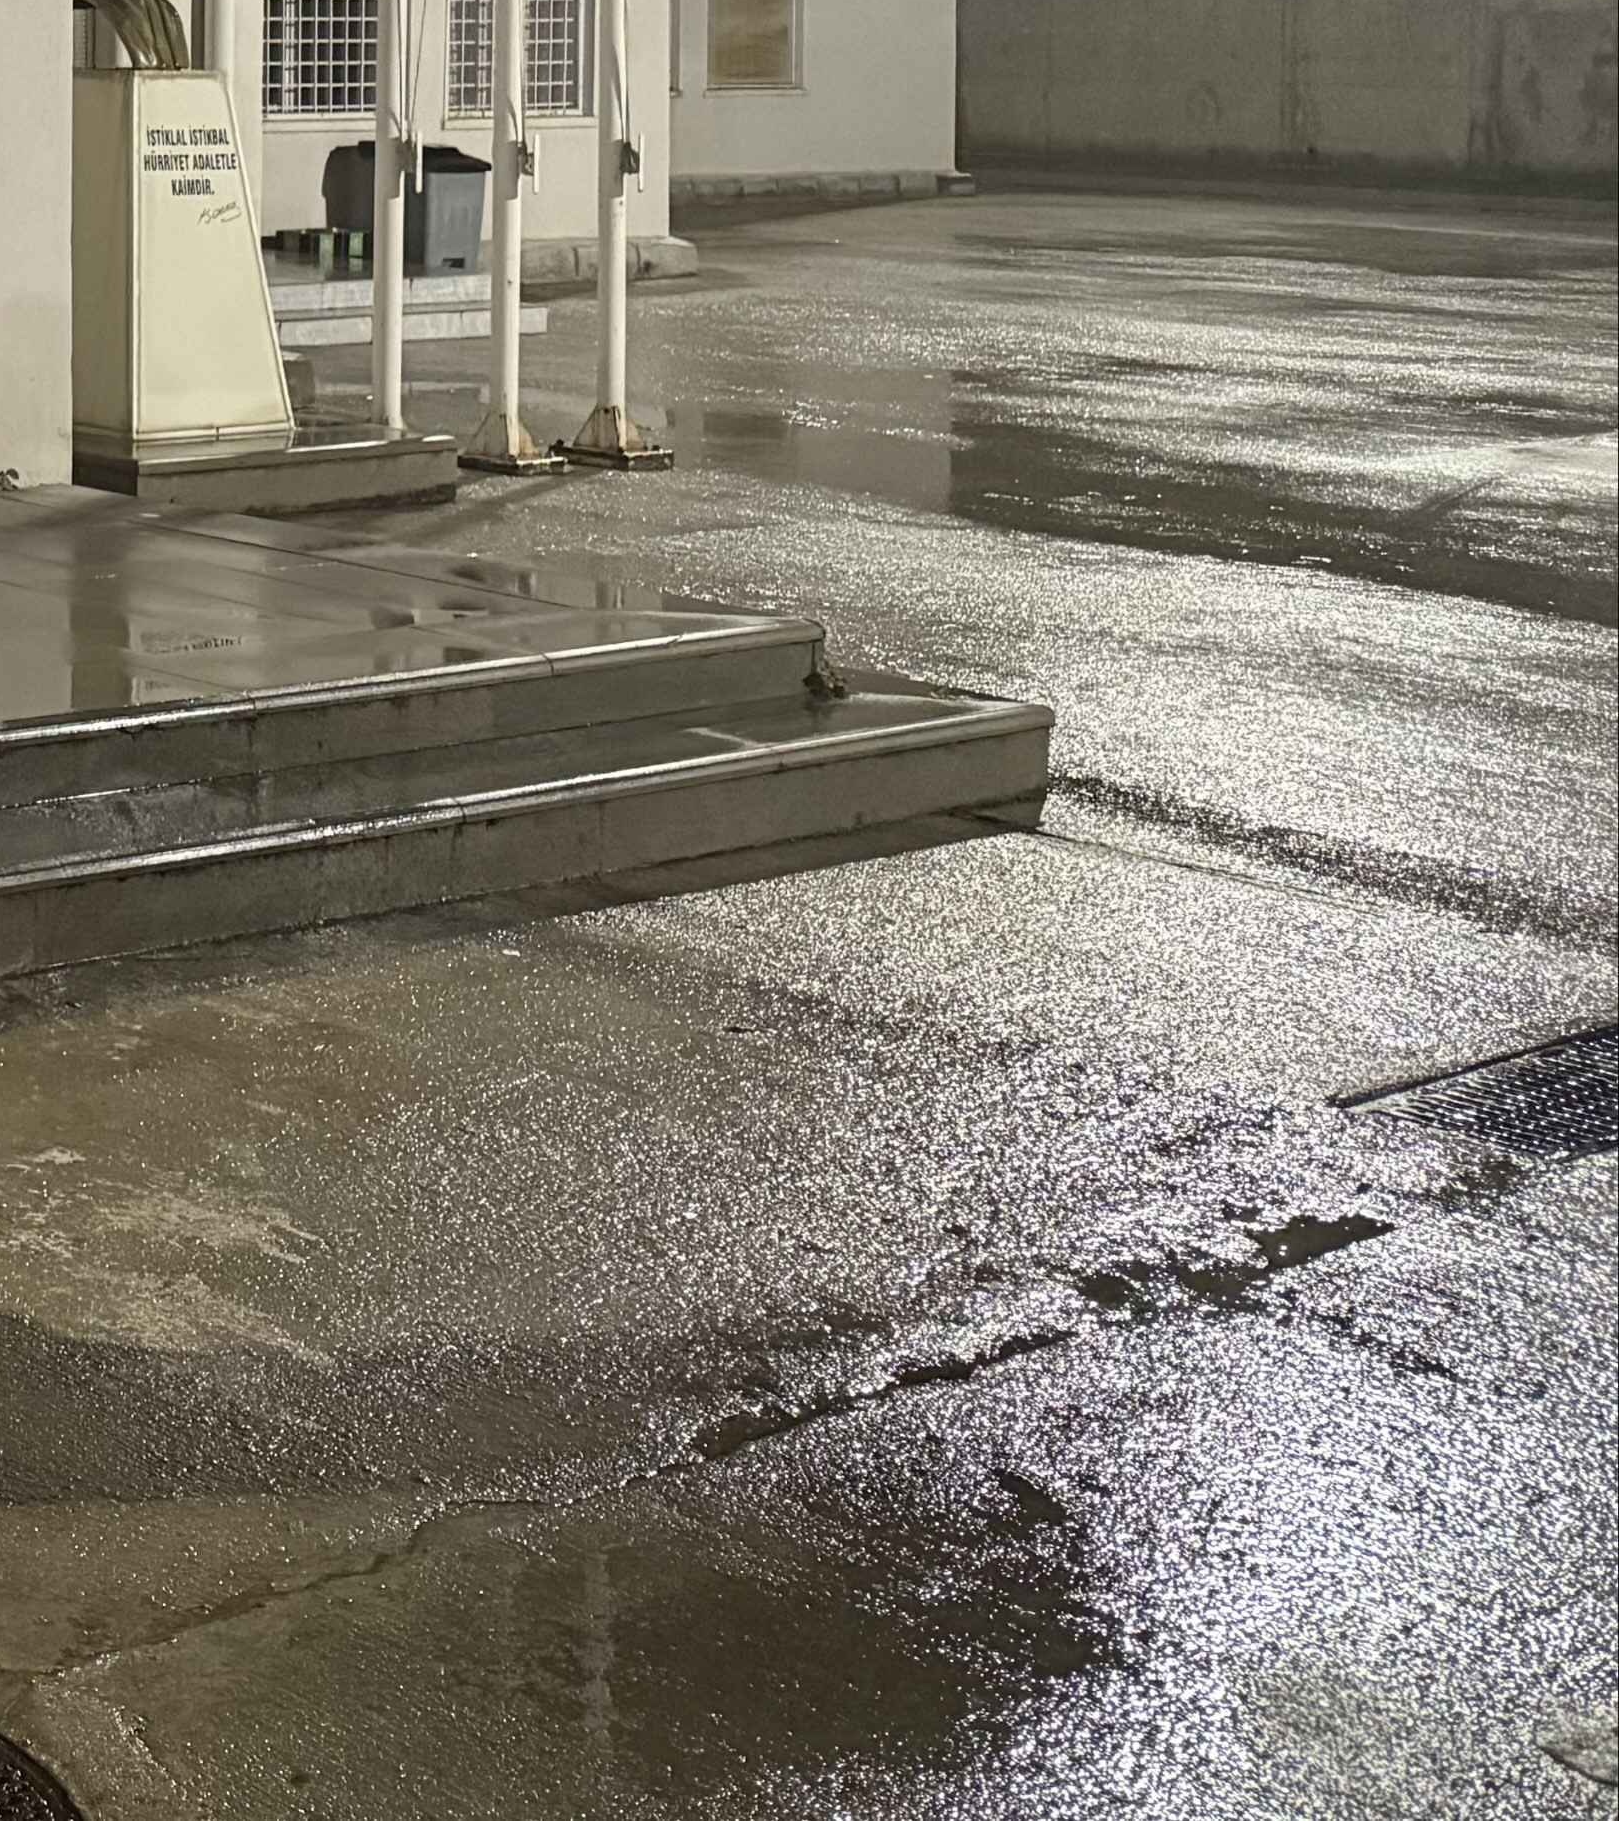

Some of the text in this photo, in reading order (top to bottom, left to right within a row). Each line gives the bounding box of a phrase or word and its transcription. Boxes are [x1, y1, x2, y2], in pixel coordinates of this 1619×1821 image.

[146, 124, 230, 146] İSTİKLAL İSTİKBAL
[143, 150, 237, 171] HÜRRİYET ADALETLE
[171, 174, 215, 196] KAİMDİR.
